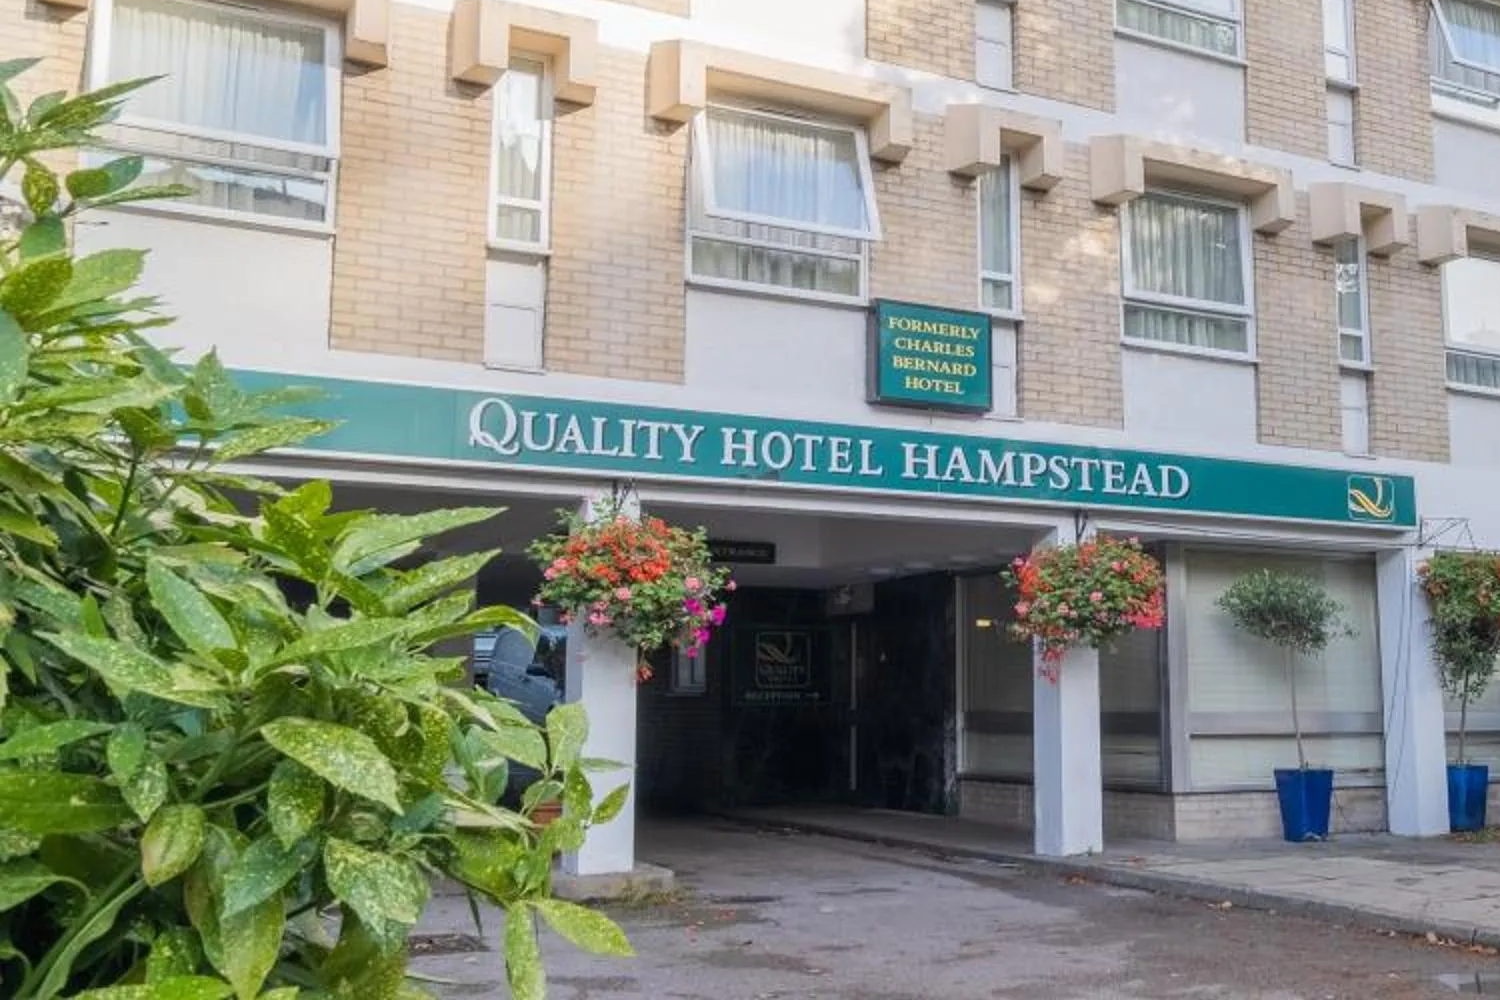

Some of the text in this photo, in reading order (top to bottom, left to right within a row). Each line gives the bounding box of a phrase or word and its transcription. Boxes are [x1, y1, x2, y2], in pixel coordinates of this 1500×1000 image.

[889, 316, 981, 340] FORMERLY
[895, 336, 975, 358] CHARLES
[893, 355, 977, 377] BERNARD
[905, 375, 966, 395] HOTEL
[468, 397, 1190, 499] QUALITY HOTEL HAMPSTEAD
